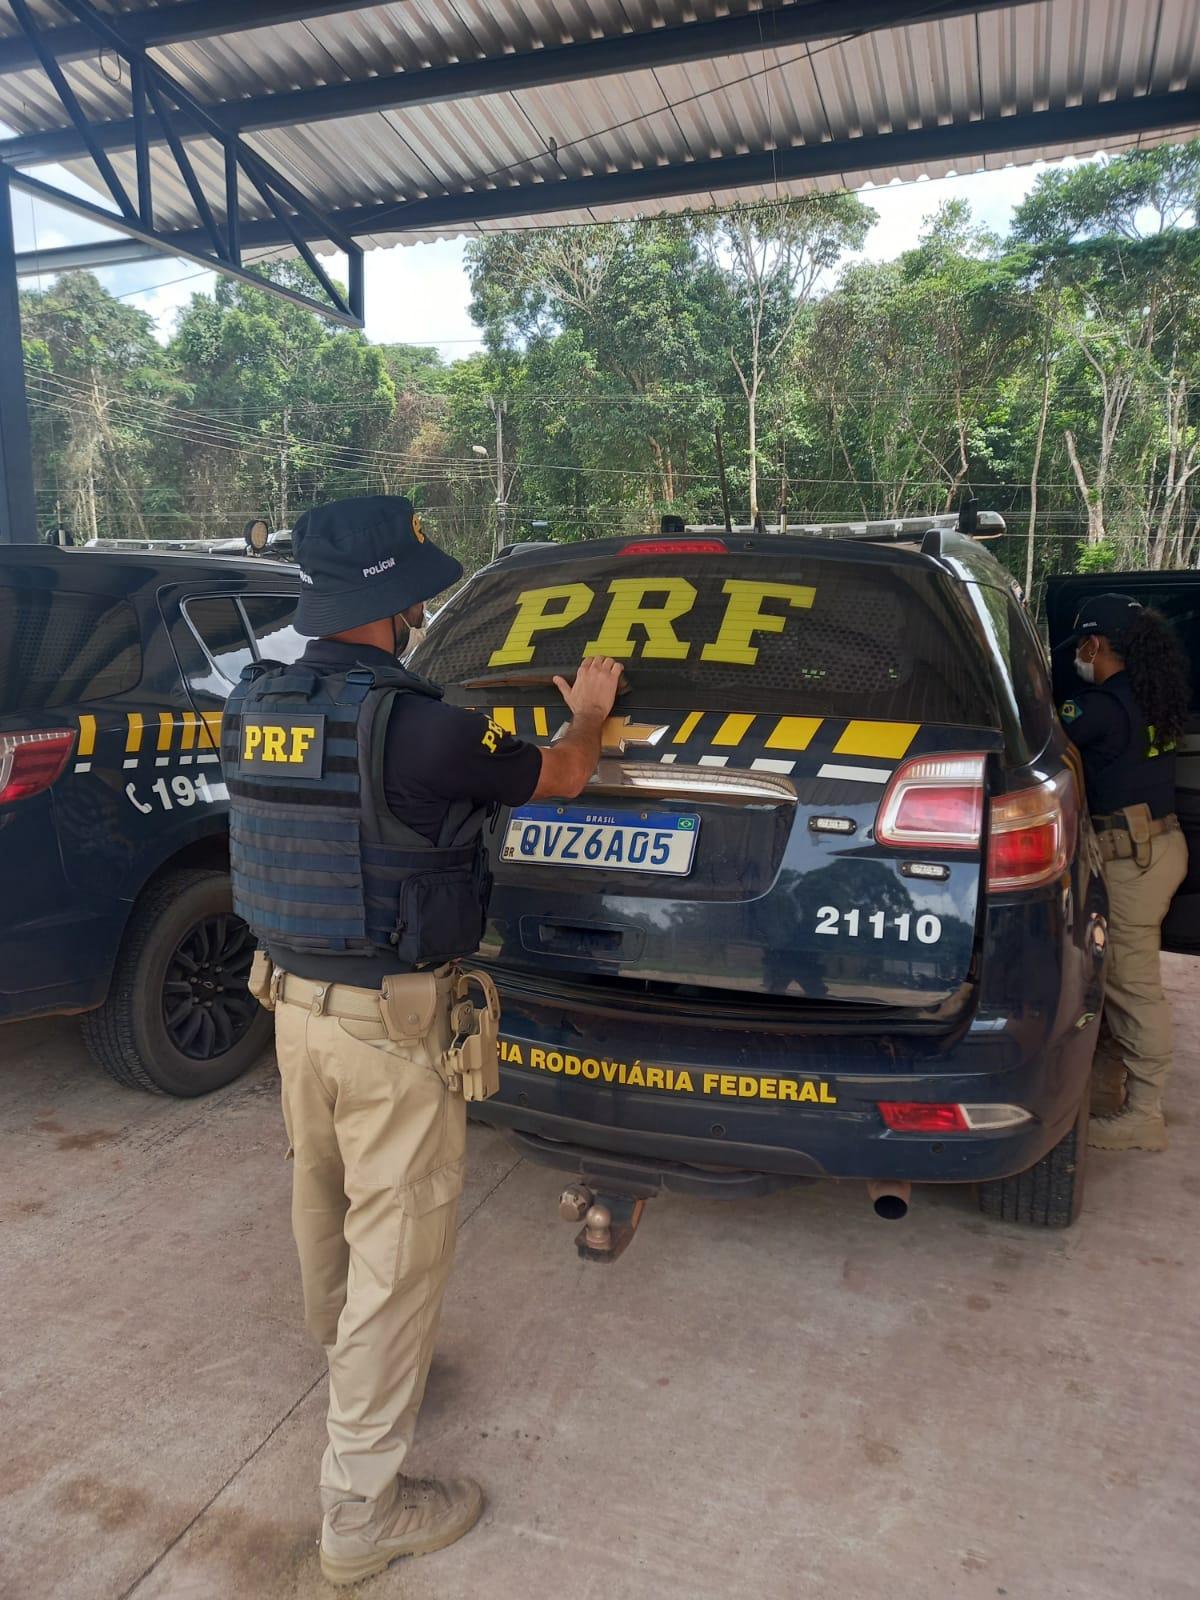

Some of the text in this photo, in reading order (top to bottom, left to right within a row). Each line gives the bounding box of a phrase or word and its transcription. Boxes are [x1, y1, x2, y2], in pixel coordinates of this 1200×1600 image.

[487, 577, 817, 668] PRF
[243, 725, 315, 763] PRF
[152, 773, 214, 810] 191
[586, 815, 616, 825] BRASIL
[503, 846, 515, 857] BR
[520, 824, 673, 865] QVZ6A05
[815, 906, 942, 944] 21110
[496, 1041, 838, 1104] IA RODOVIÁRIA FEDERAL
